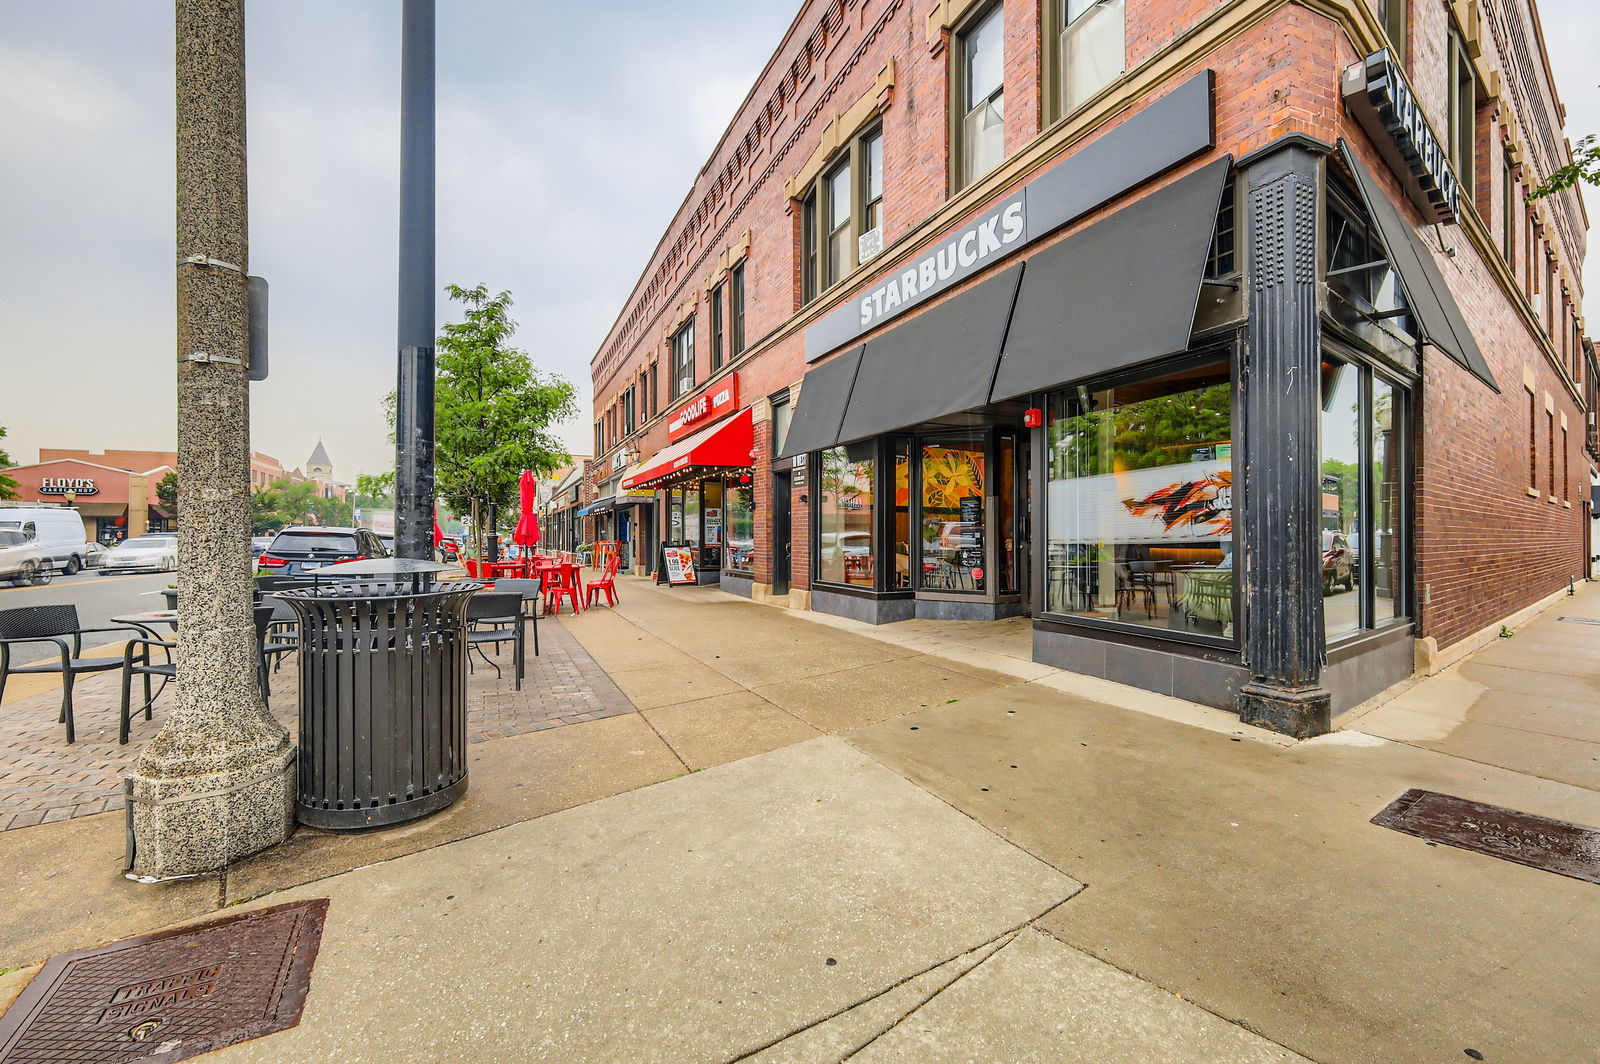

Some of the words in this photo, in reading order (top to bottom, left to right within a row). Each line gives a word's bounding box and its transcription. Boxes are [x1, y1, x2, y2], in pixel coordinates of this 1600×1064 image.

[1383, 46, 1461, 224] STARBUCKS
[860, 201, 1025, 326] STARBUCKS
[680, 396, 707, 425] GOODLIFE
[713, 389, 730, 408] PIZZA
[42, 477, 95, 488] FLOYD'S
[122, 966, 221, 1000] TRAFFIC
[105, 985, 212, 1021] SIGNALS
